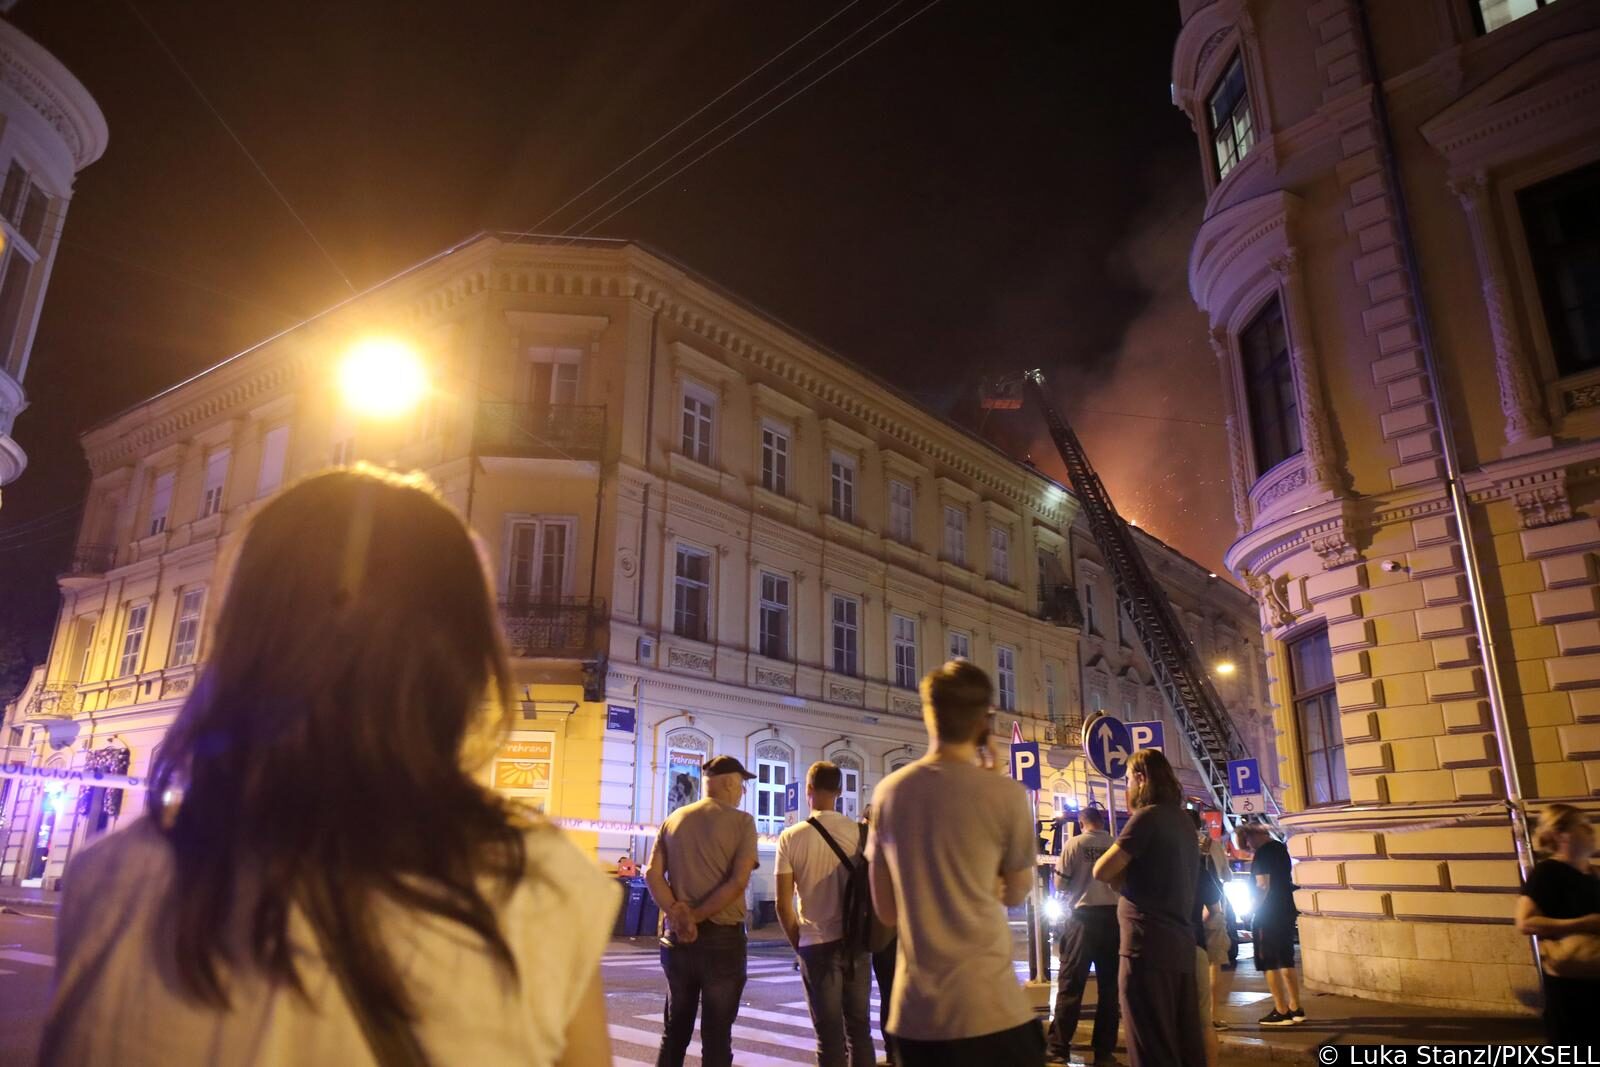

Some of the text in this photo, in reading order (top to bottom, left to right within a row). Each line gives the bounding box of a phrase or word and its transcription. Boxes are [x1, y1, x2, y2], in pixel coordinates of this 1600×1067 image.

[1132, 726, 1153, 750] P
[1015, 751, 1035, 781] P
[1236, 766, 1250, 789] P
[788, 788, 795, 806] P
